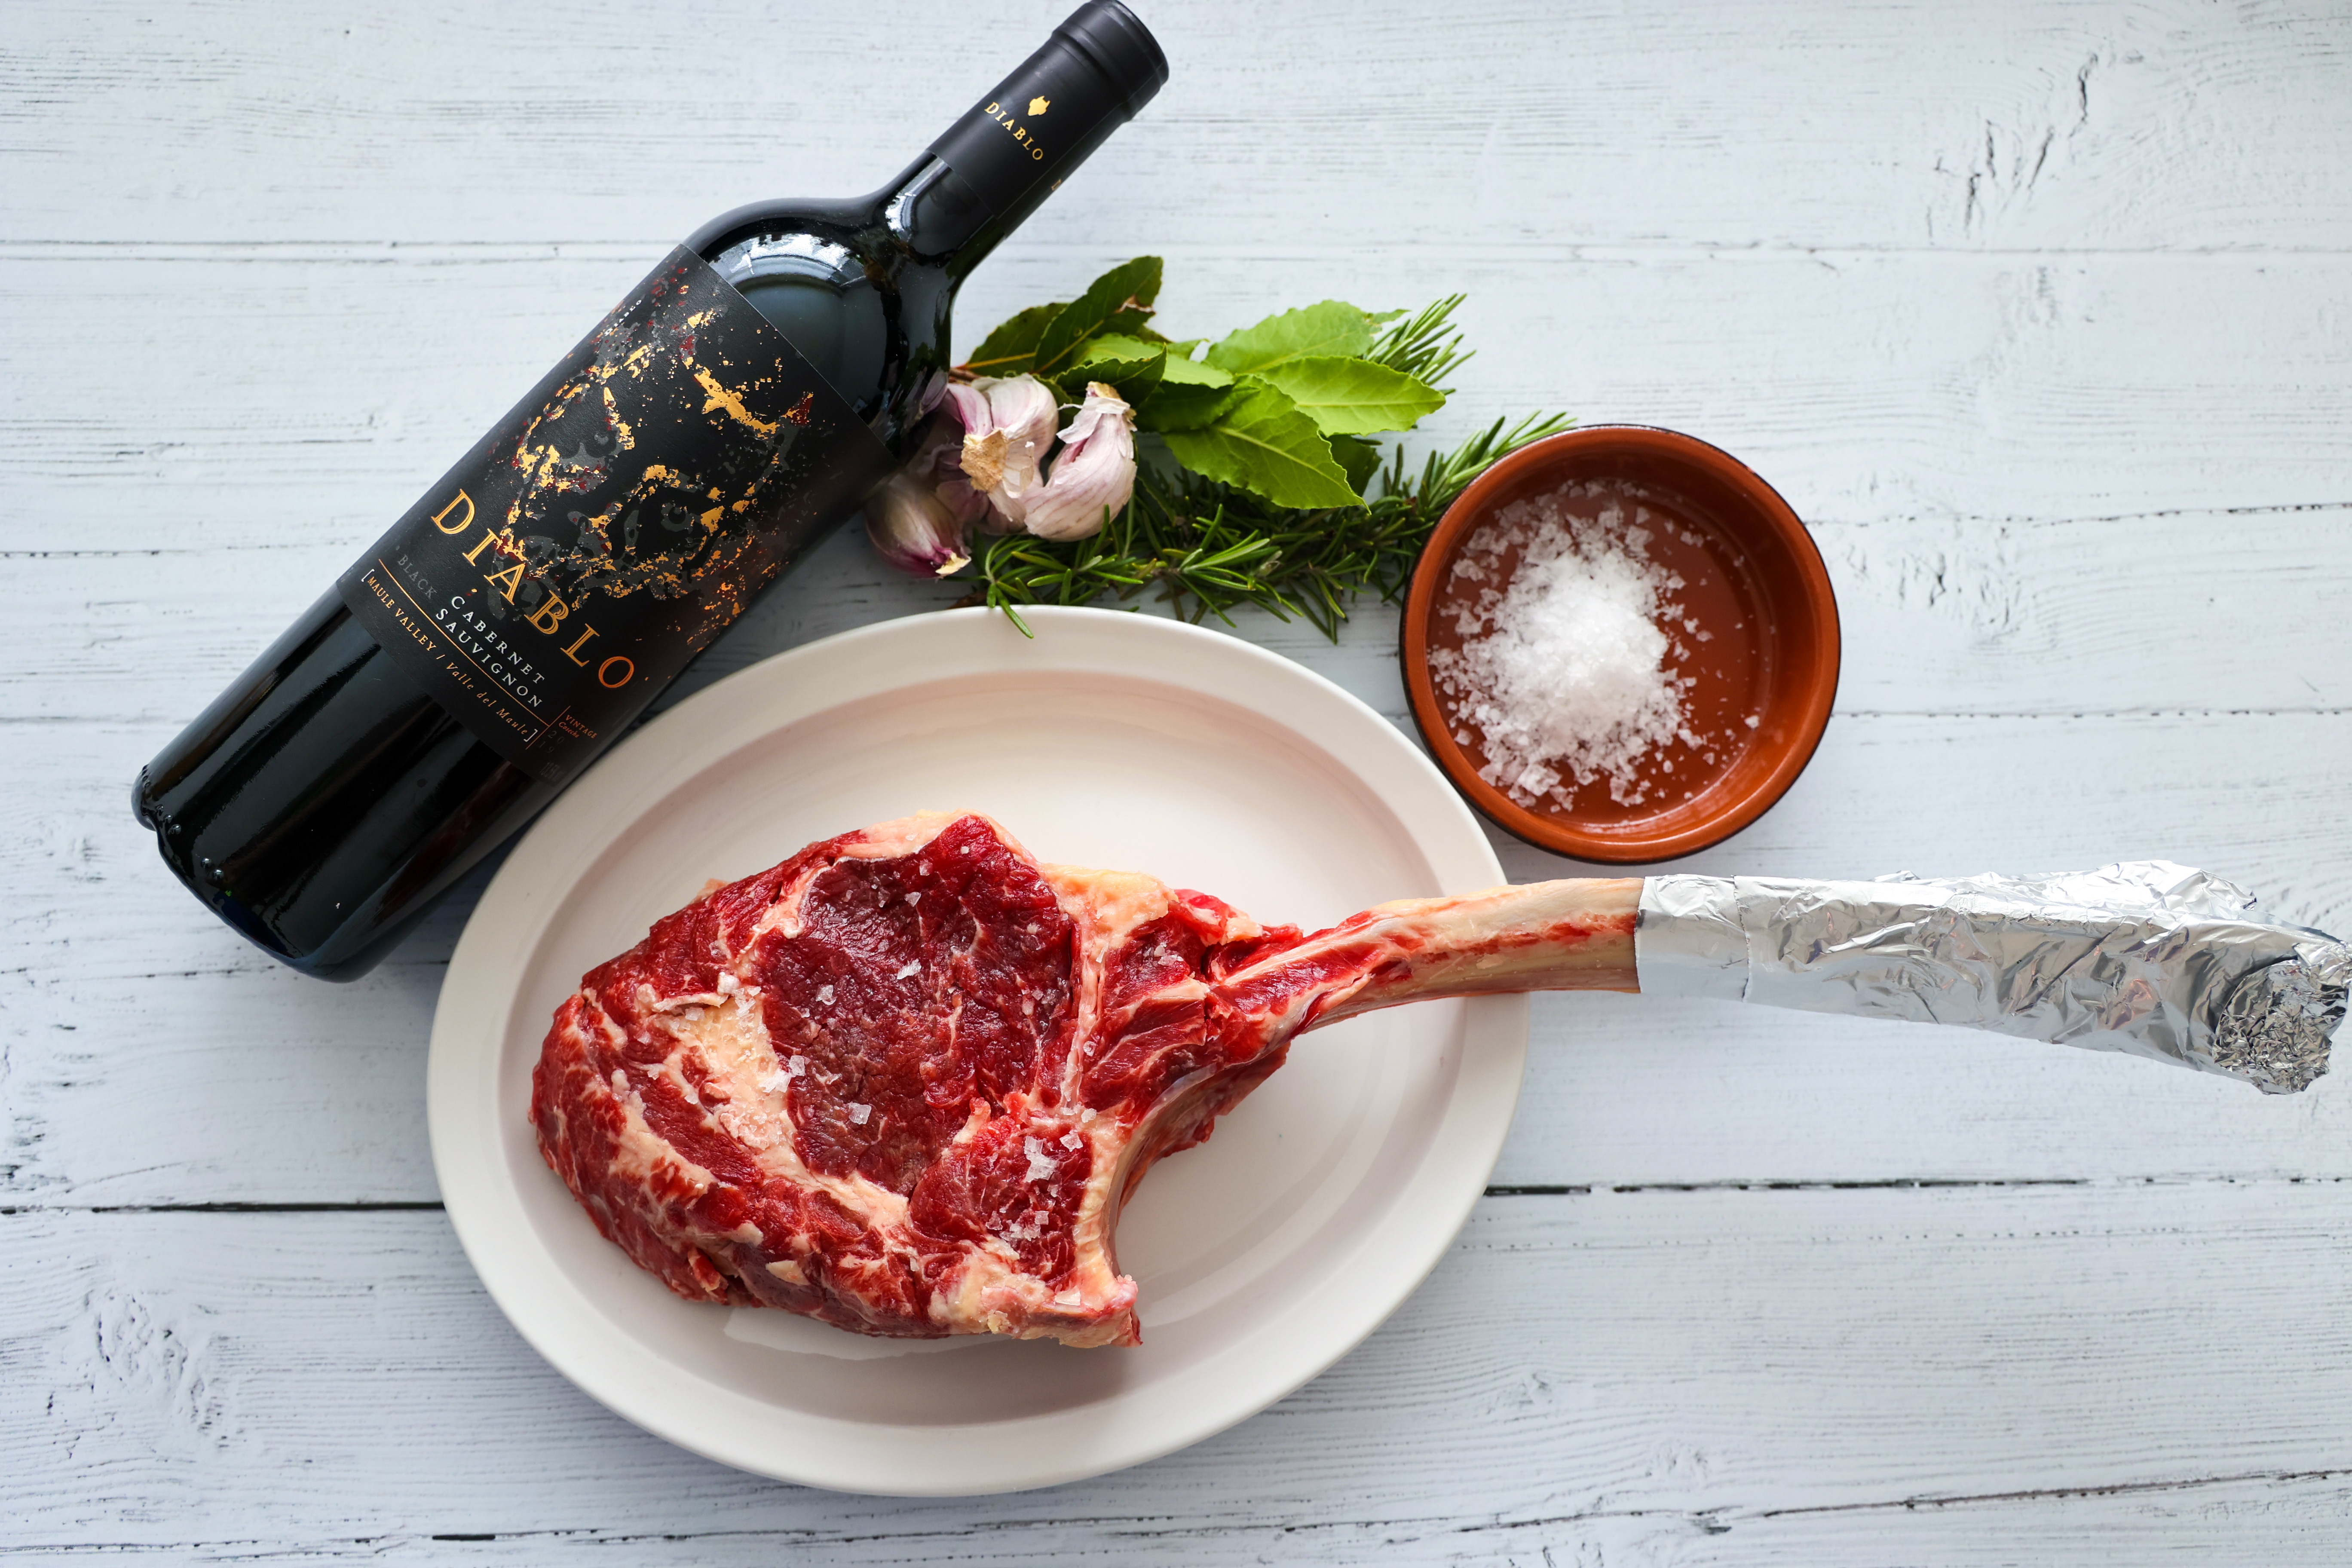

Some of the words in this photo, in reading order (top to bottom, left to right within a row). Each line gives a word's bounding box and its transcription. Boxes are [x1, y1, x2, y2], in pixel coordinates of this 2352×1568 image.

[984, 101, 1044, 160] DIABLO
[604, 300, 642, 336] DIABLO
[397, 554, 438, 600] BLACK
[431, 488, 634, 688] DIABLO
[395, 608, 437, 652] VALLEY
[446, 661, 474, 690] Valle
[477, 691, 498, 708] del
[436, 609, 542, 707] SAUVIGNON
[451, 596, 545, 684] CABERNET
[558, 721, 580, 738] Cosecha
[565, 714, 598, 739] VINTAGE
